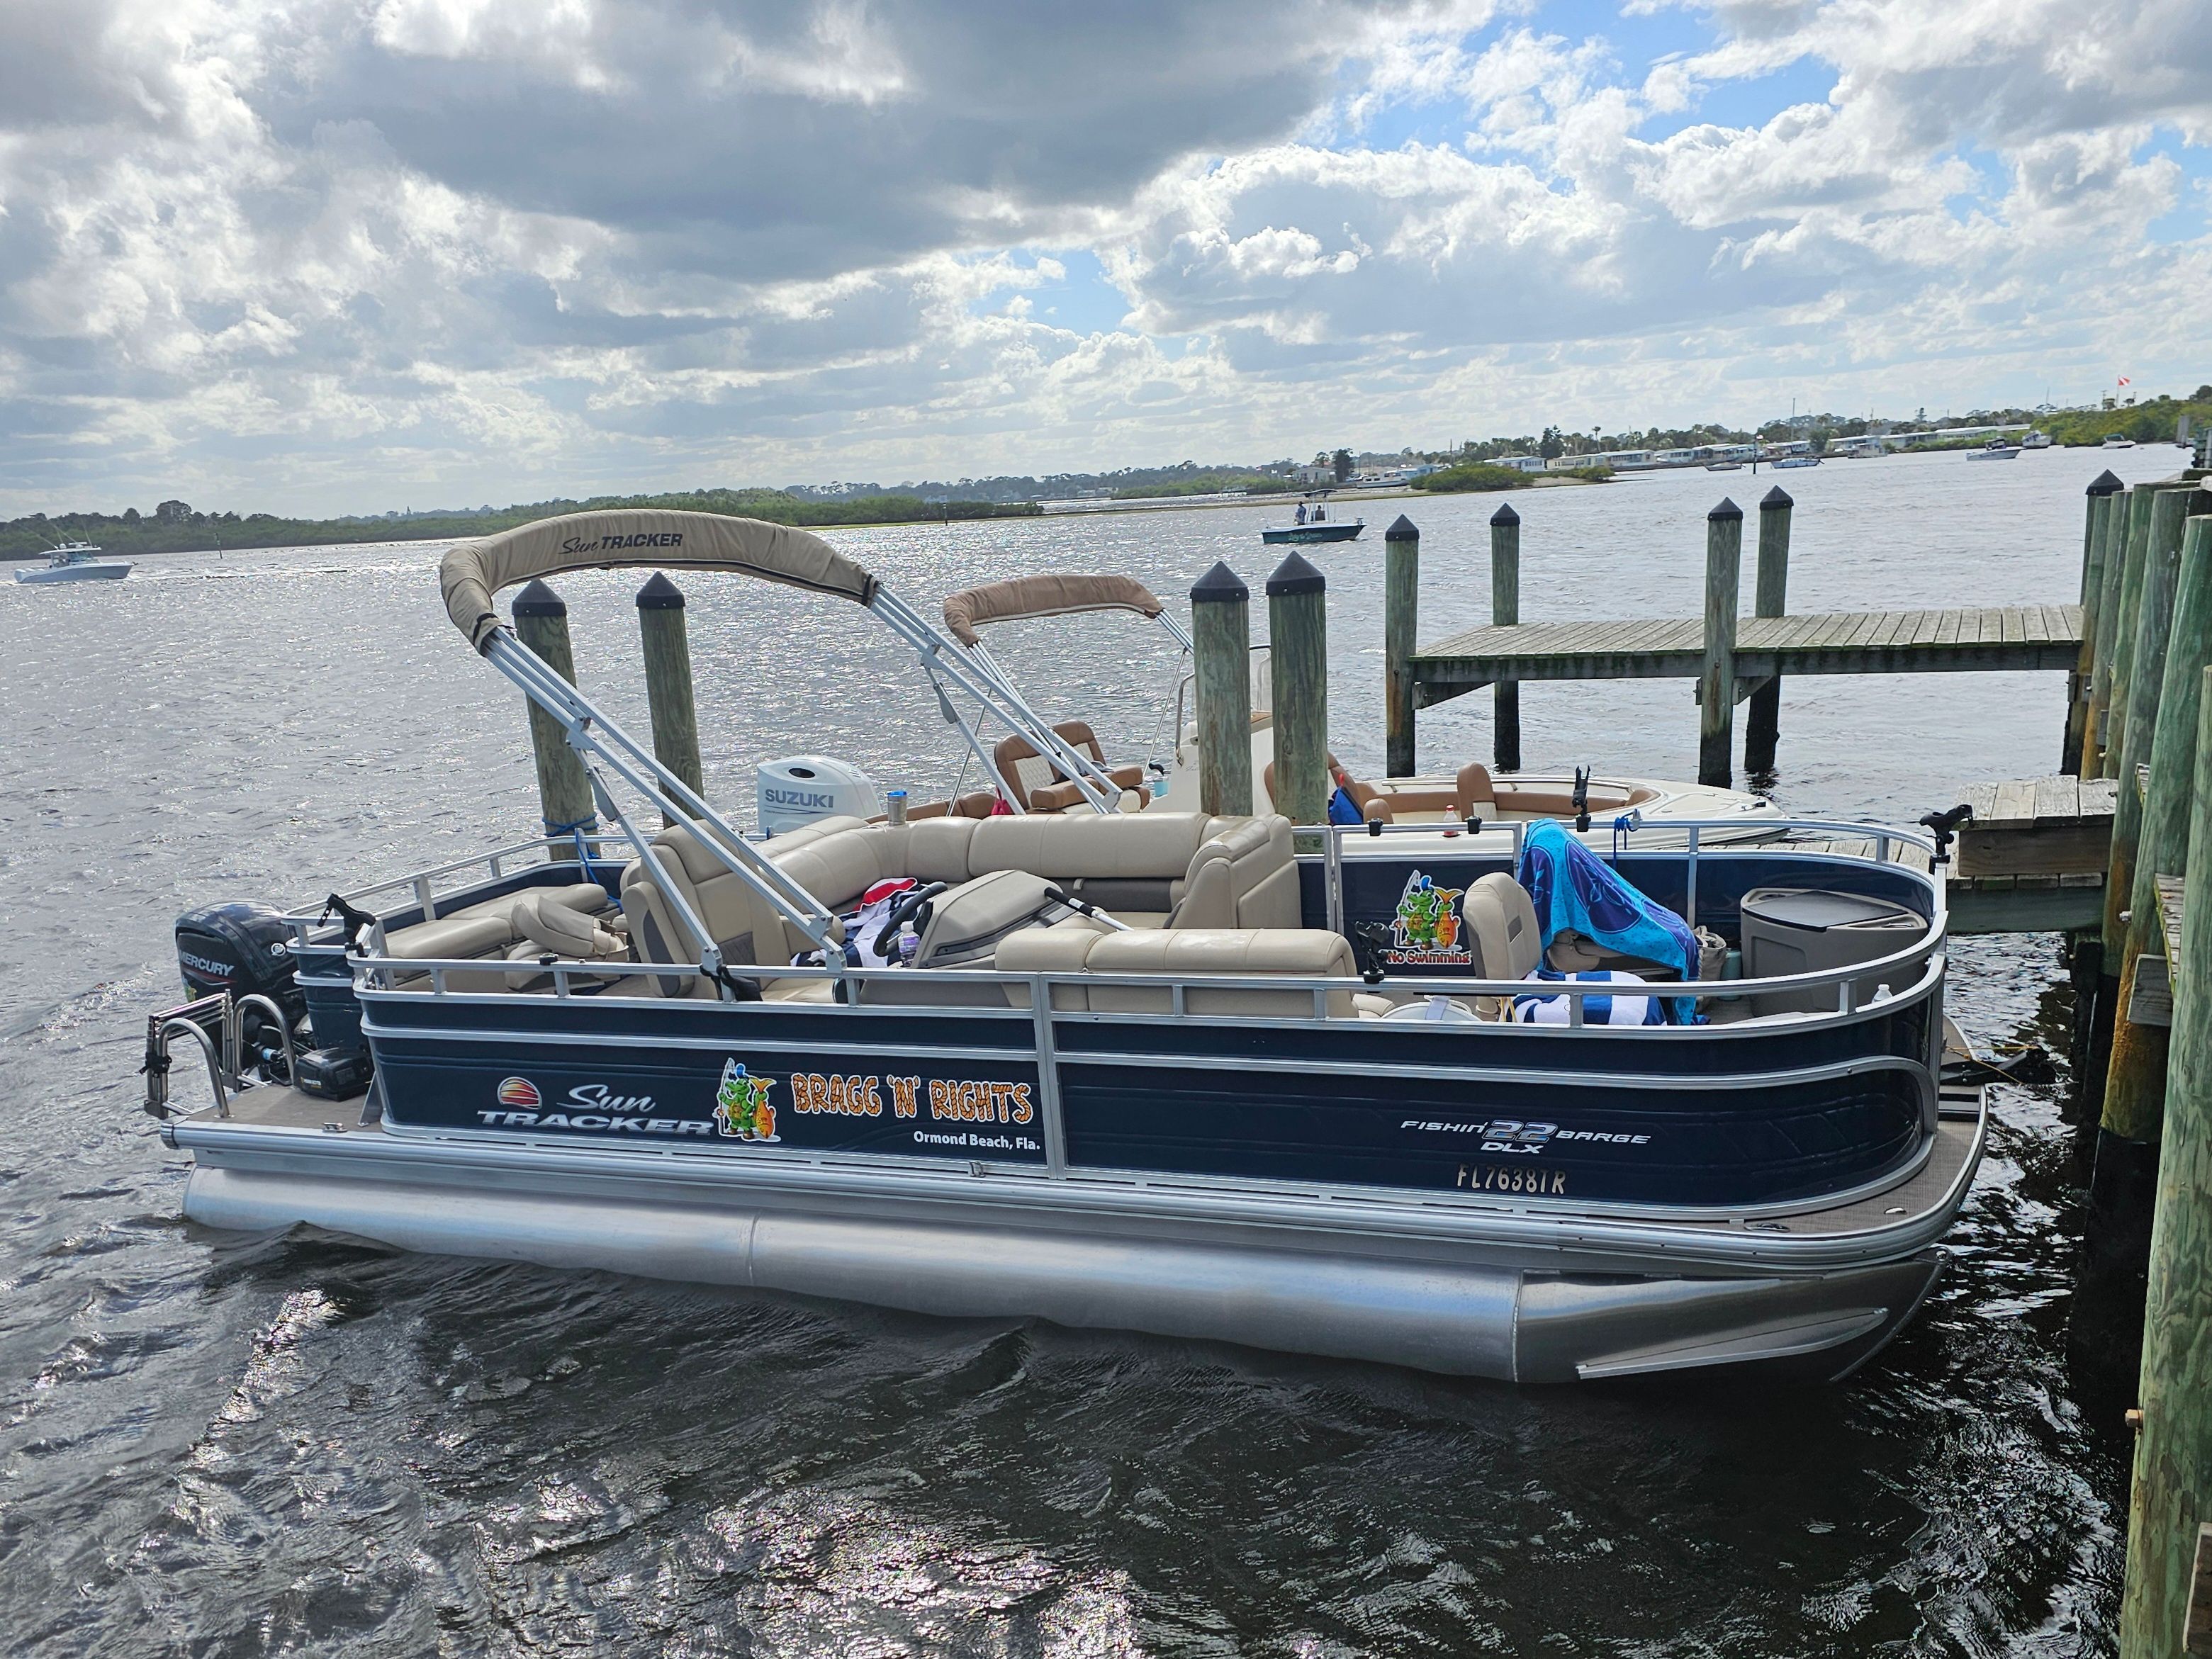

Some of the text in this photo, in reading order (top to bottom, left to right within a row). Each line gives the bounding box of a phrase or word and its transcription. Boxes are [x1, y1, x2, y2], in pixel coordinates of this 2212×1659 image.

[558, 533, 683, 554] Sun TRACKER
[765, 789, 833, 808] SUZUKI
[179, 950, 235, 977] MERCURY
[1387, 950, 1405, 964] No
[556, 1084, 656, 1113] Sun
[791, 1073, 1034, 1125] BRAGG 'N' RIGHTS
[477, 1110, 714, 1135] TRACKER
[1481, 1120, 1558, 1143] 22
[1556, 1130, 1651, 1145] BARGE
[914, 1131, 1040, 1151] Ormond Beach, Fla.
[1481, 1142, 1544, 1154] DLX
